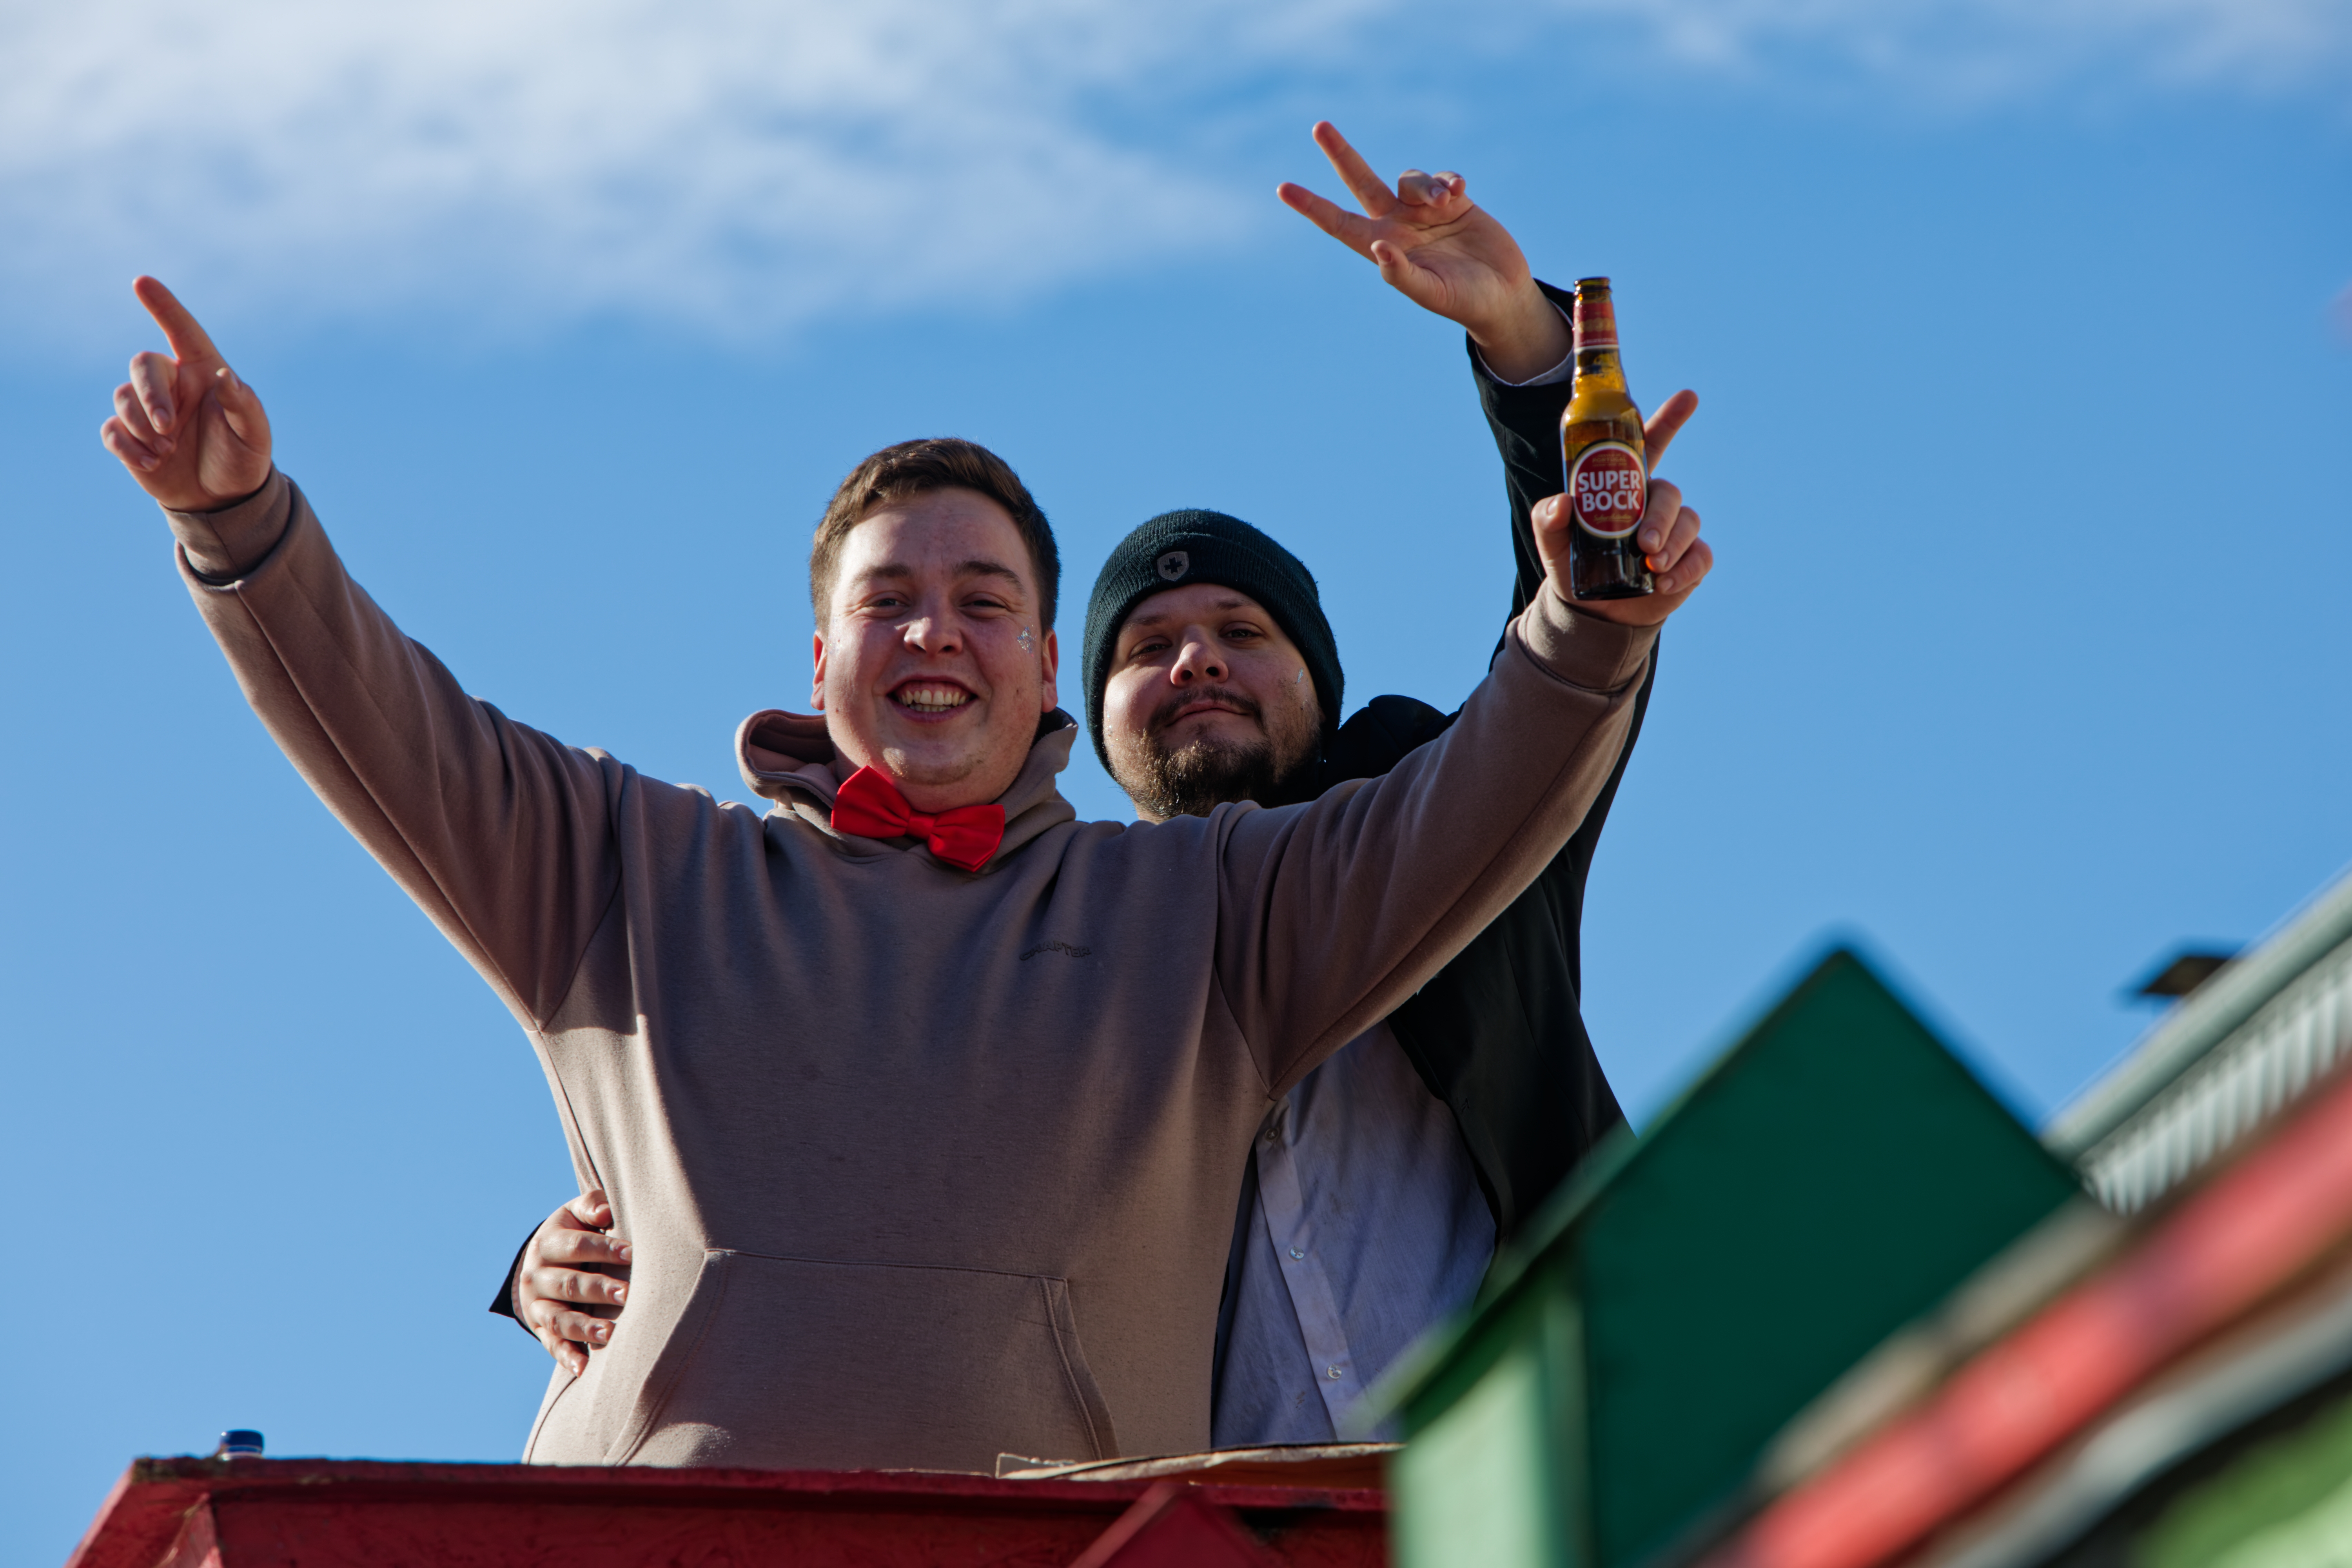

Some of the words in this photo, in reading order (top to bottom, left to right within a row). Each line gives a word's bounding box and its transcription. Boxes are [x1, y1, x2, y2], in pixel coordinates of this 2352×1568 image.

[1578, 470, 1641, 492] SUPER
[1582, 490, 1641, 512] BOCK
[1019, 940, 1092, 961] CHAPTER
